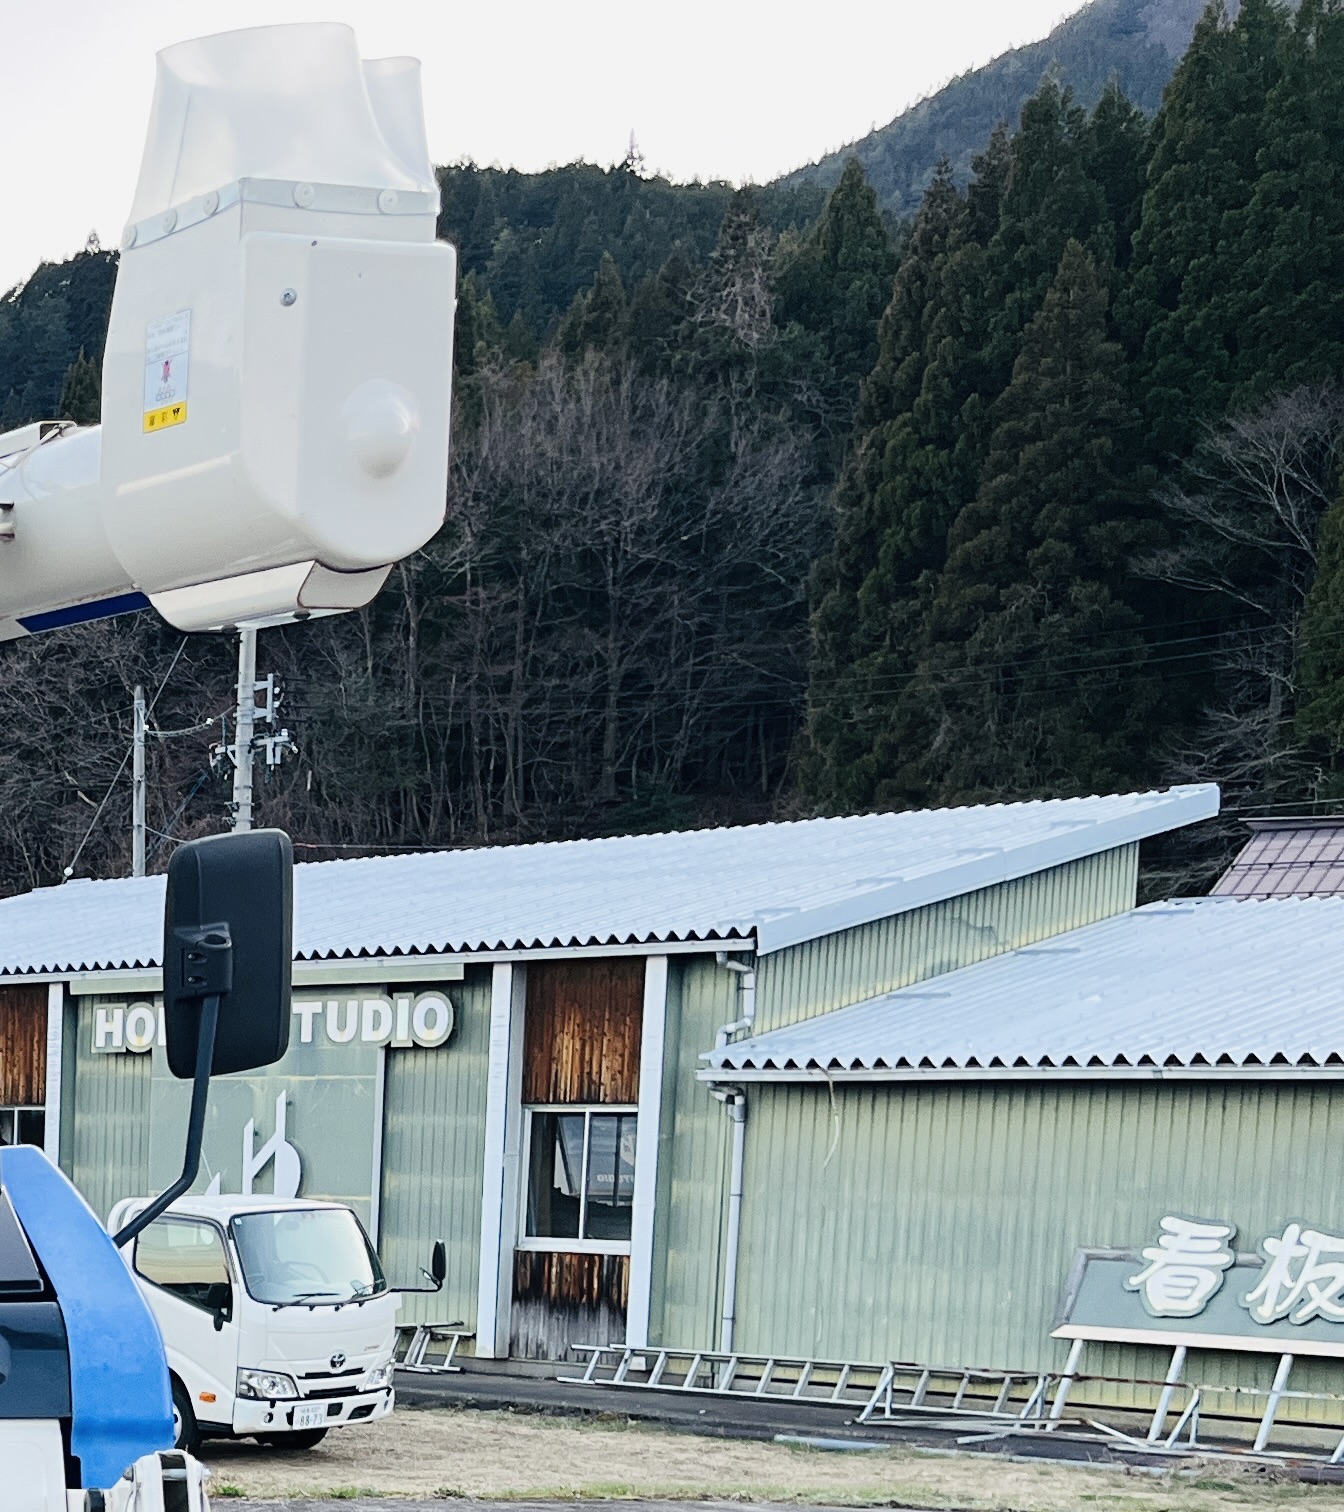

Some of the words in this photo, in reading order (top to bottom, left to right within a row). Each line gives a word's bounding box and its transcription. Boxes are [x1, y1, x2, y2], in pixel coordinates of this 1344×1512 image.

[95, 1006, 167, 1048] HO
[291, 995, 448, 1044] TUDIO
[1128, 1214, 1344, 1320] 看板
